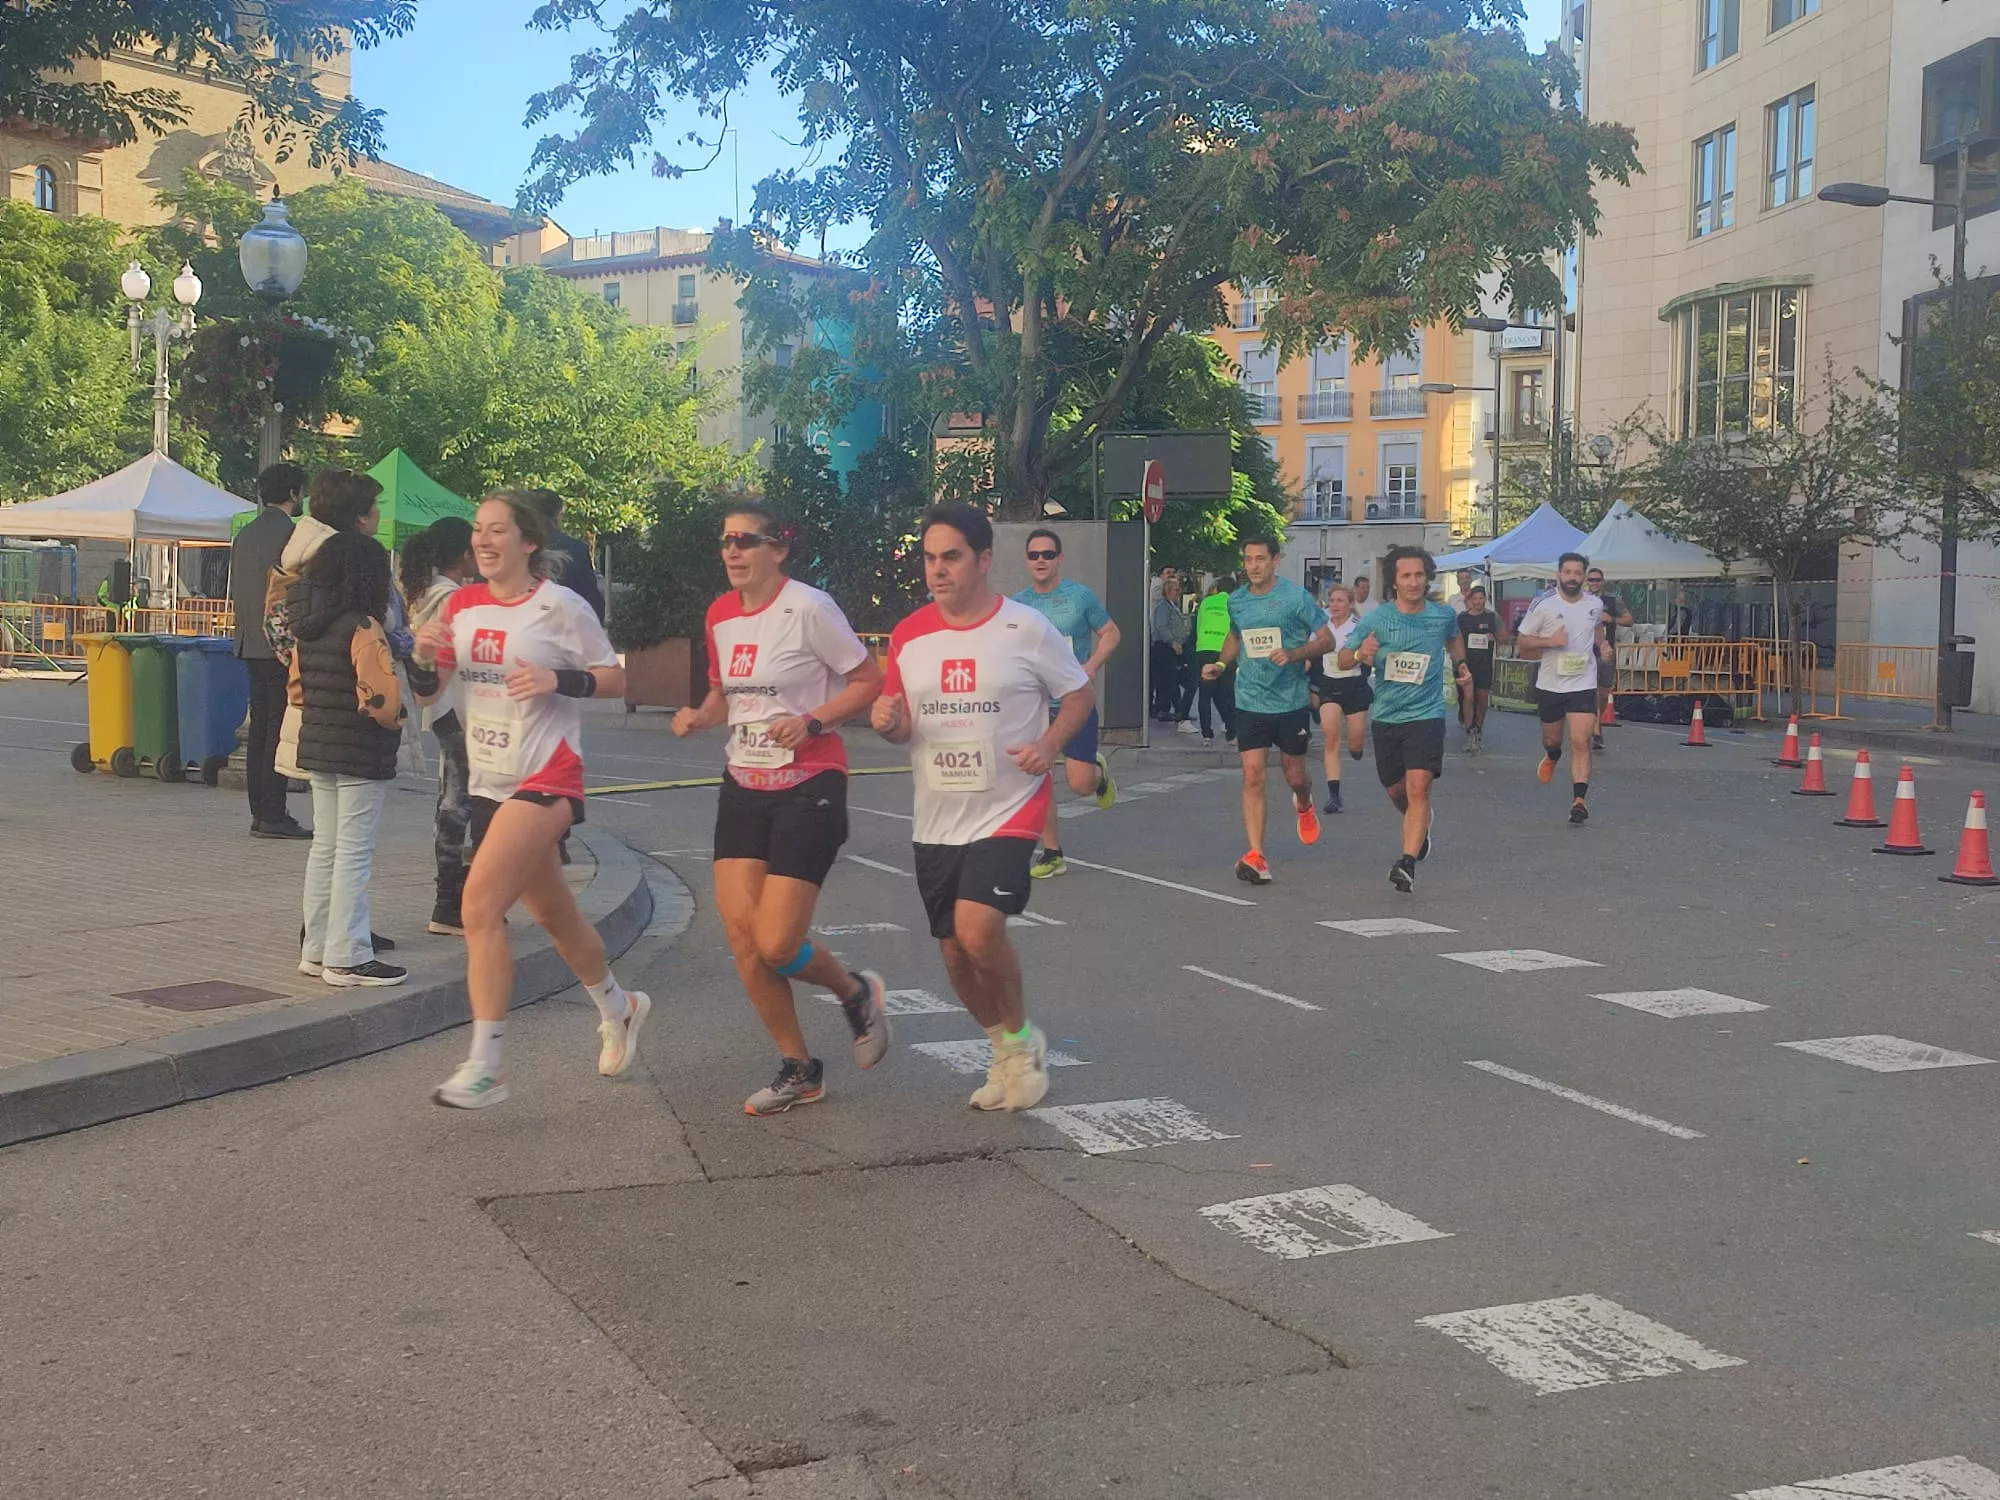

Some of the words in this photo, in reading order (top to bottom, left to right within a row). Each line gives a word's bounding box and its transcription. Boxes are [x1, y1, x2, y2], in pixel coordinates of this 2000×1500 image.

[1249, 635, 1274, 645] 1021
[921, 699, 1001, 715] salesianos
[933, 750, 983, 768] 4021
